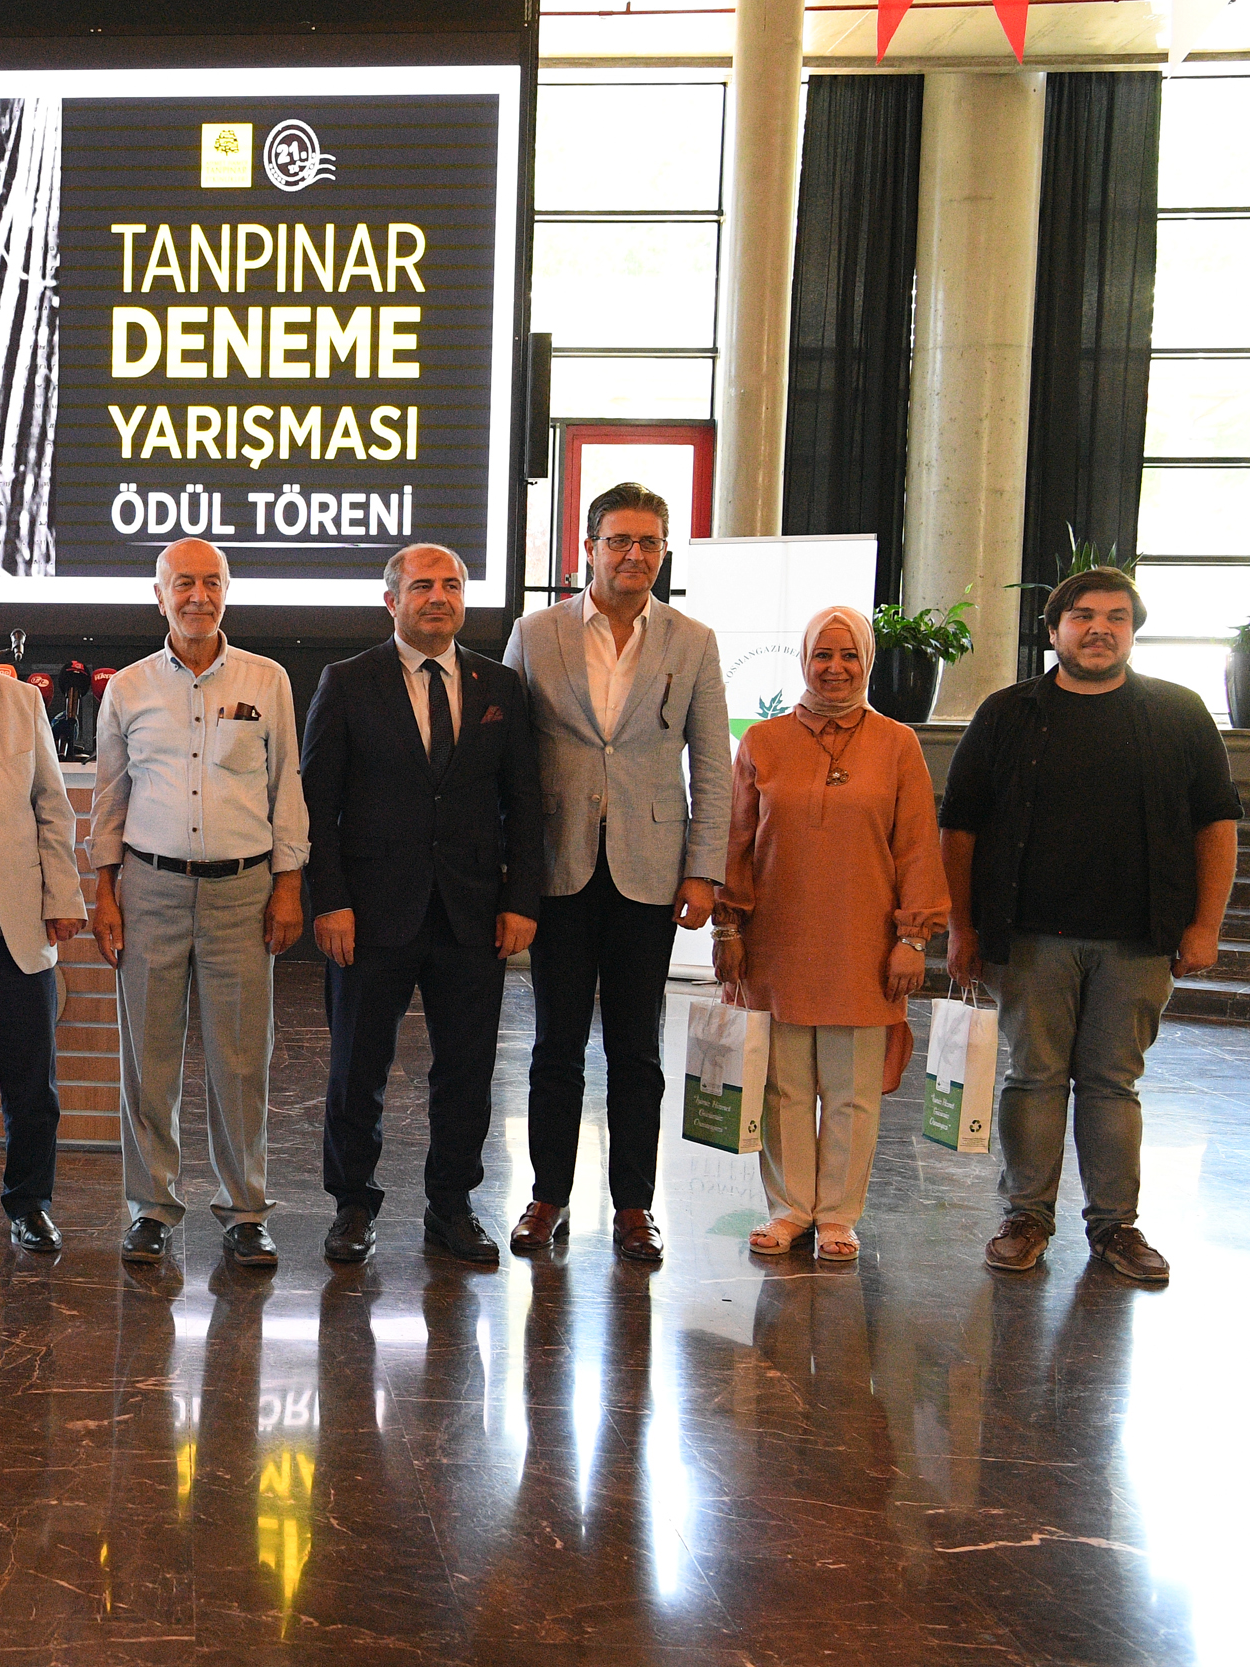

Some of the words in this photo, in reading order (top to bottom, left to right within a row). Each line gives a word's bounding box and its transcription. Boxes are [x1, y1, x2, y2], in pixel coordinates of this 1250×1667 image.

[276, 141, 307, 165] 21.
[110, 223, 426, 293] TANPINAR
[111, 306, 421, 379] DENEME
[107, 405, 418, 470] YARIŞMASI
[111, 483, 235, 535] ÖDÜL
[248, 484, 413, 536] TÖRENİ
[726, 643, 781, 679] OSMANGAZİ
